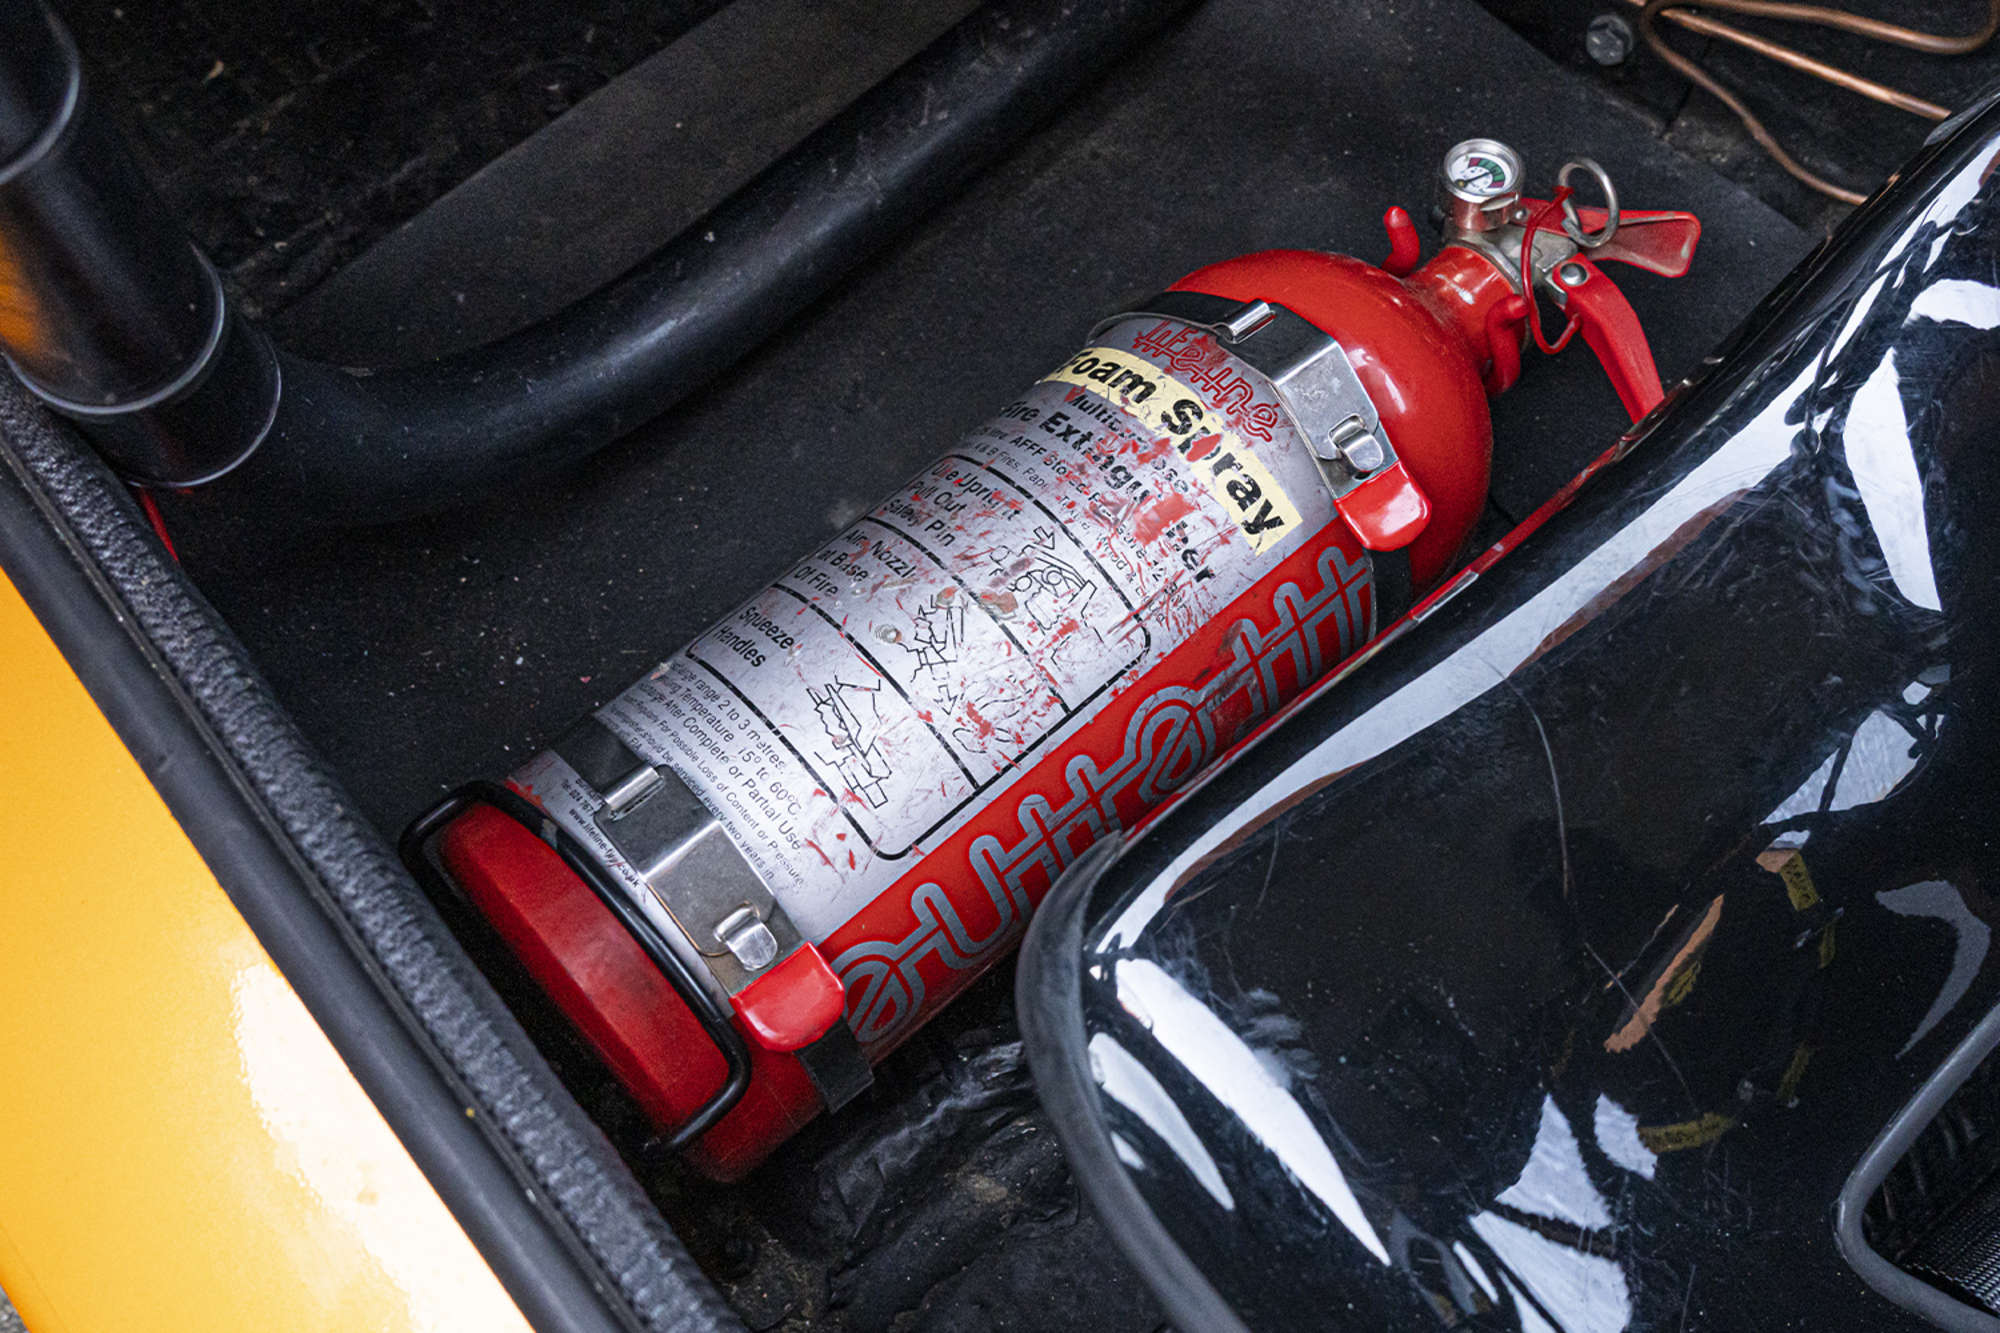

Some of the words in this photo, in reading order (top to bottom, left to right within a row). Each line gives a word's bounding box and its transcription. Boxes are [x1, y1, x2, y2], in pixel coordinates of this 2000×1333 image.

[1008, 436, 1046, 456] AFFF
[1055, 351, 1156, 403] Foam
[1162, 398, 1285, 535] Spray
[931, 461, 960, 481] Ue
[934, 491, 966, 512] Out
[1038, 410, 1217, 582] Extinguher
[924, 520, 956, 547] Pin
[829, 552, 868, 582] Base
[869, 540, 915, 580] Nozzl
[807, 572, 837, 597] Fire
[712, 625, 766, 668] Handles
[739, 607, 792, 649] Squeeze
[680, 688, 734, 743] Temperature
[693, 679, 720, 702] range
[716, 698, 731, 711] 2
[725, 707, 740, 722] to
[736, 717, 751, 731] 3
[658, 720, 672, 733] For
[669, 731, 699, 762] Possible
[696, 759, 719, 783] Loss
[715, 780, 728, 793] of
[725, 790, 760, 829] Content
[756, 828, 769, 841] or
[662, 700, 685, 718] After
[683, 717, 729, 765] Complete
[727, 764, 743, 781] or
[740, 777, 782, 822] Partial
[661, 750, 675, 763] be
[724, 820, 743, 841] two
[740, 840, 766, 868] years
